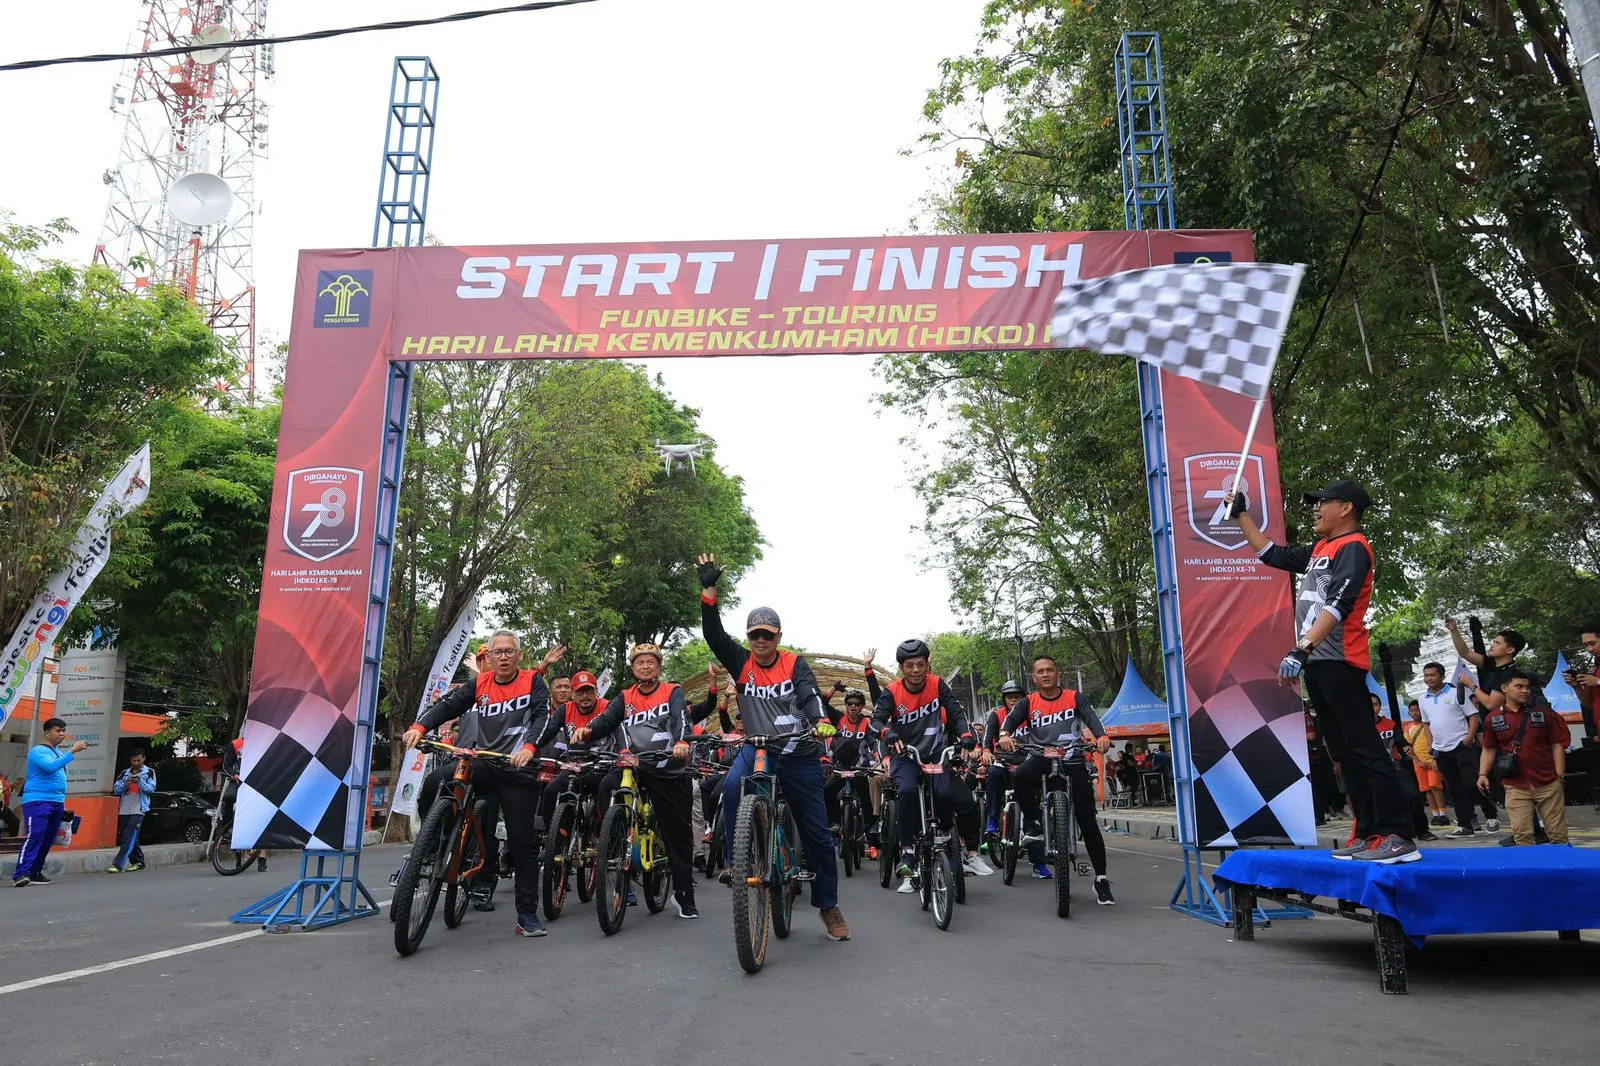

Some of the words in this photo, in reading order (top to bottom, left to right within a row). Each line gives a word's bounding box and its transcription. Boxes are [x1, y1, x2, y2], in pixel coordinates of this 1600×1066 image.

[456, 252, 735, 299] START
[800, 243, 1083, 293] FINISH
[600, 307, 751, 329] FUNBIKE
[782, 303, 938, 325] TOURING
[402, 335, 486, 356] HARI
[493, 333, 600, 354] LAHIR
[606, 325, 900, 352] KEMENKUMHAM
[907, 322, 1035, 347] (HDKD)
[1200, 459, 1240, 468] DIRGAHAY
[303, 473, 348, 482] DIRGAHAYU
[301, 487, 347, 538] 78
[308, 568, 363, 576] KEMENKUMHAM
[442, 628, 468, 674] Festival
[745, 679, 795, 700] HDKD
[896, 697, 939, 725] HDKD
[1030, 708, 1075, 728] HDKD
